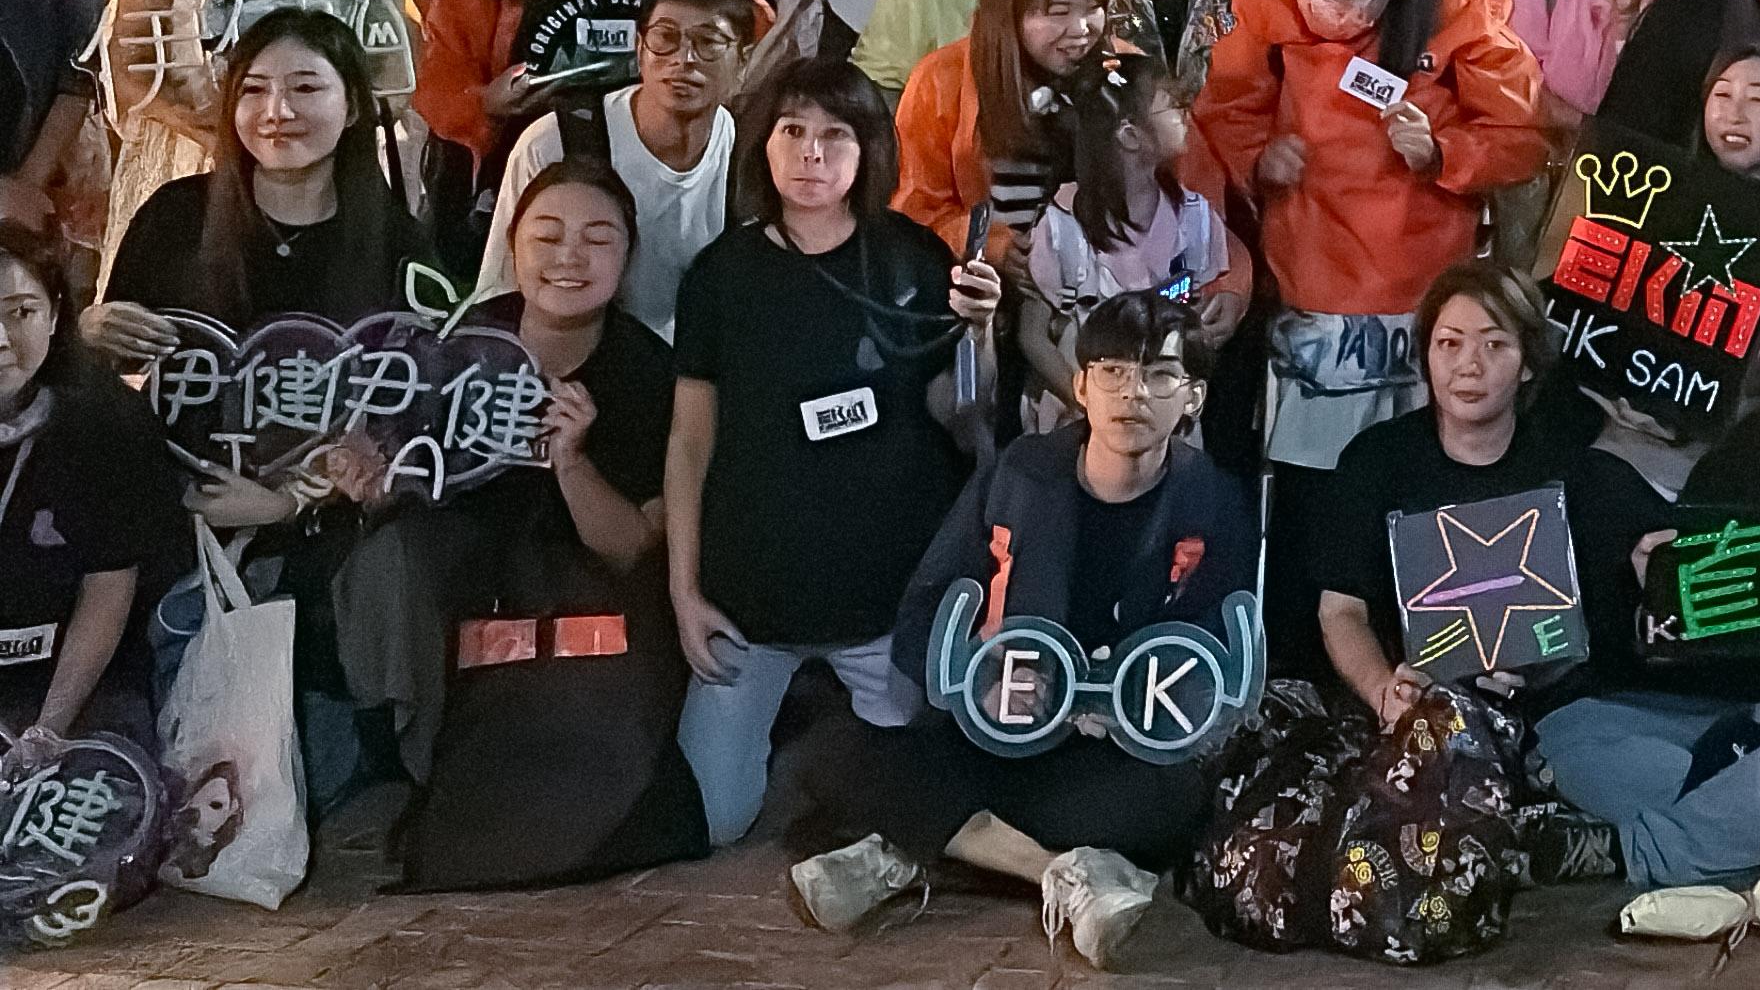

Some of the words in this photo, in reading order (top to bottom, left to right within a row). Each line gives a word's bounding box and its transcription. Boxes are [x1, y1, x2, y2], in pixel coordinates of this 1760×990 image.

[1625, 349, 1719, 412] SAM
[1532, 615, 1570, 656] E
[1647, 615, 1677, 644] K
[999, 650, 1040, 724] E
[1143, 656, 1198, 734] K
